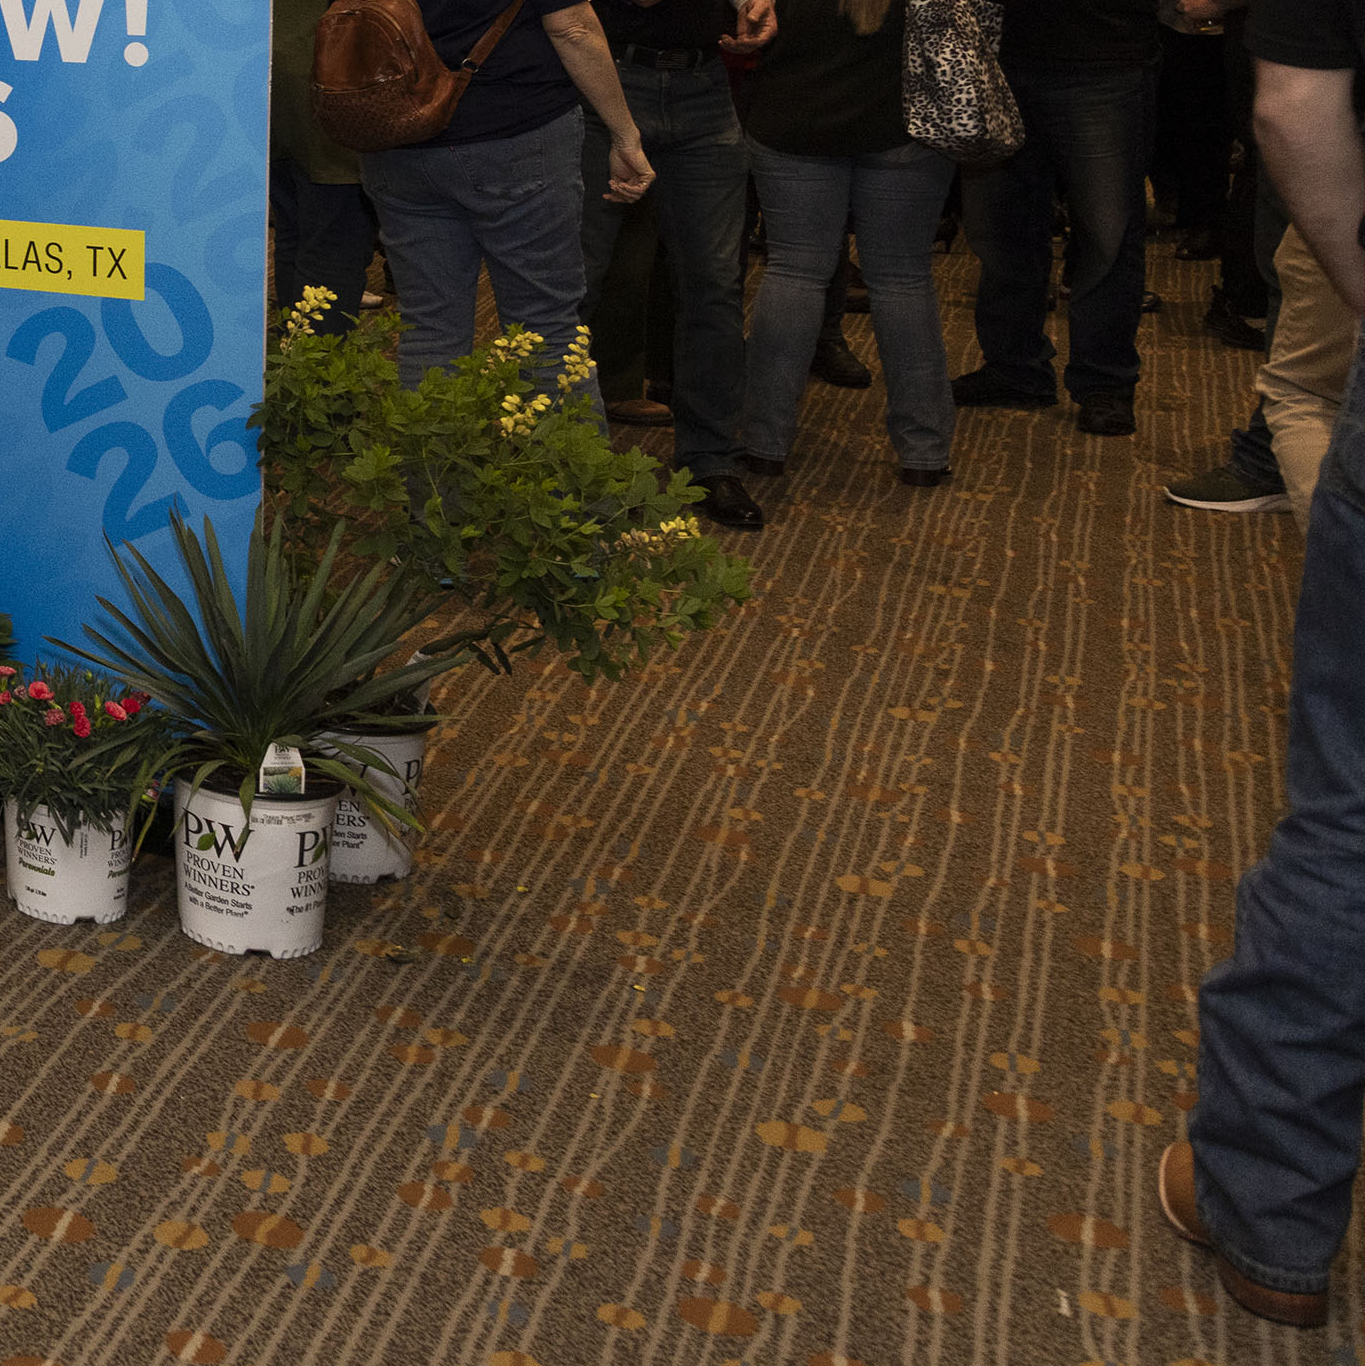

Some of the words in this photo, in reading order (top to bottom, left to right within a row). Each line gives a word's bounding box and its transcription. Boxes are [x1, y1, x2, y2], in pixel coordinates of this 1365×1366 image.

[86, 245, 129, 280] TX
[182, 806, 256, 864] PW
[294, 822, 332, 869] P
[19, 839, 52, 856] PROVEN
[186, 850, 245, 880] PROVEN
[204, 891, 230, 905] Garden
[230, 898, 253, 910] Starts
[290, 882, 324, 899] WINN
[204, 901, 225, 915] Better
